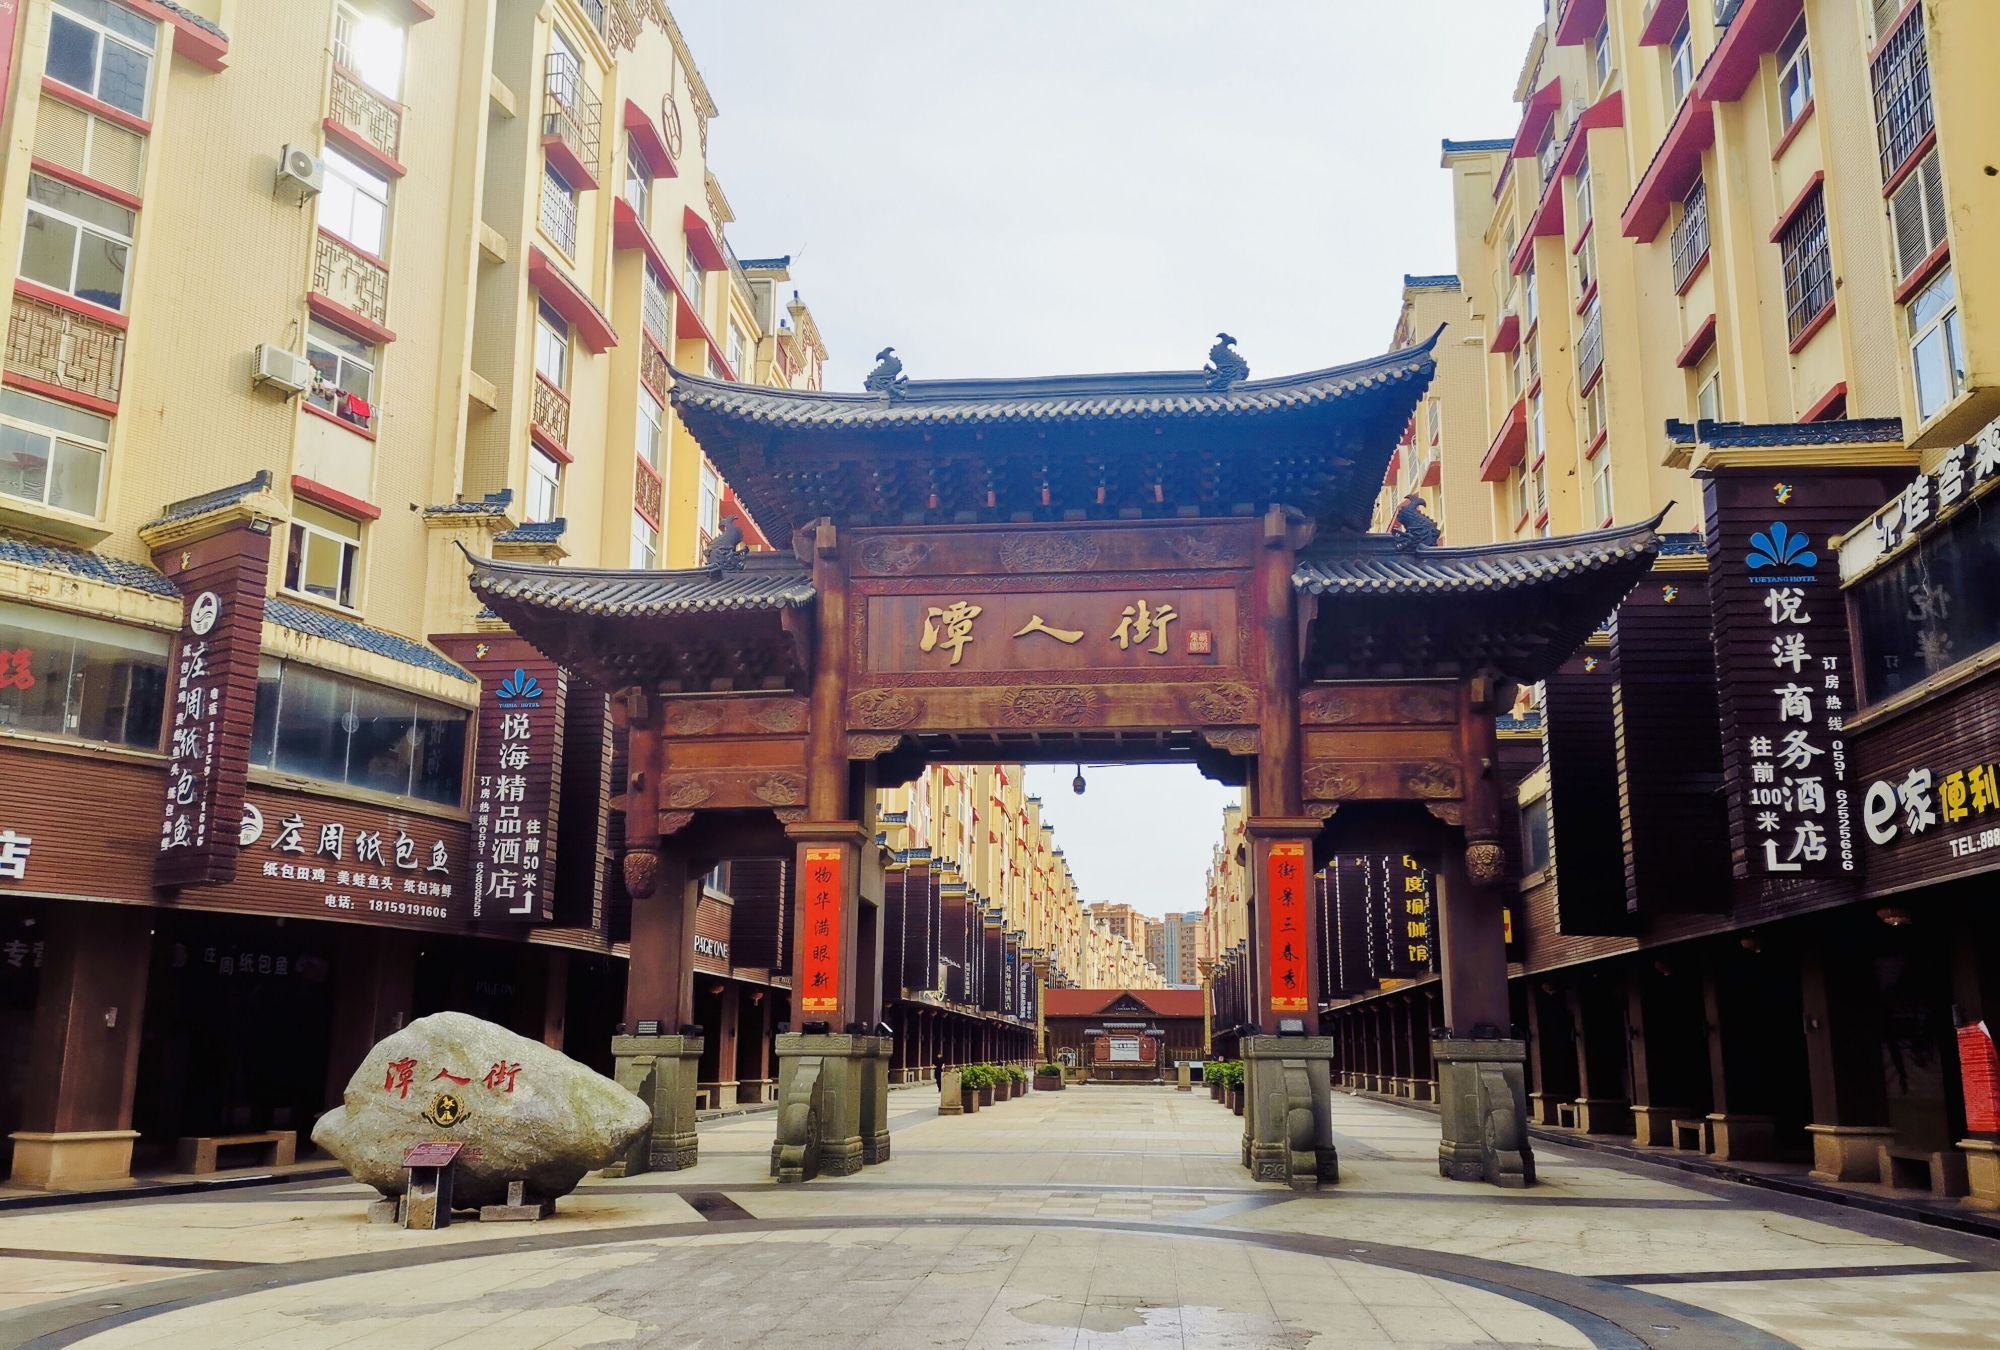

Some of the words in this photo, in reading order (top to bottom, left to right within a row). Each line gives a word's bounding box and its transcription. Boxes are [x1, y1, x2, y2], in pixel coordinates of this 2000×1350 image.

[919, 600, 1178, 666] 潭人街
[1763, 587, 1828, 862] 悦洋商务酒店
[1821, 656, 1844, 732] 订房热线
[168, 642, 206, 847] 庄周纸包鱼
[1831, 740, 1846, 781] 0591
[485, 712, 531, 899] 悦海精品酒店
[1750, 735, 1782, 832] 往前100米
[270, 813, 450, 874] 庄周纸包鱼
[521, 819, 541, 888] 往前50米
[1835, 789, 1854, 871] 62525666
[262, 861, 326, 883] 纸包田鸡
[336, 869, 393, 891] 美蛙鱼头
[403, 878, 452, 899] 纸包海鲜
[368, 899, 448, 919] 18159191606
[694, 935, 713, 954] PAGE
[713, 940, 731, 958] ONE
[384, 1056, 523, 1100] 潭人街
